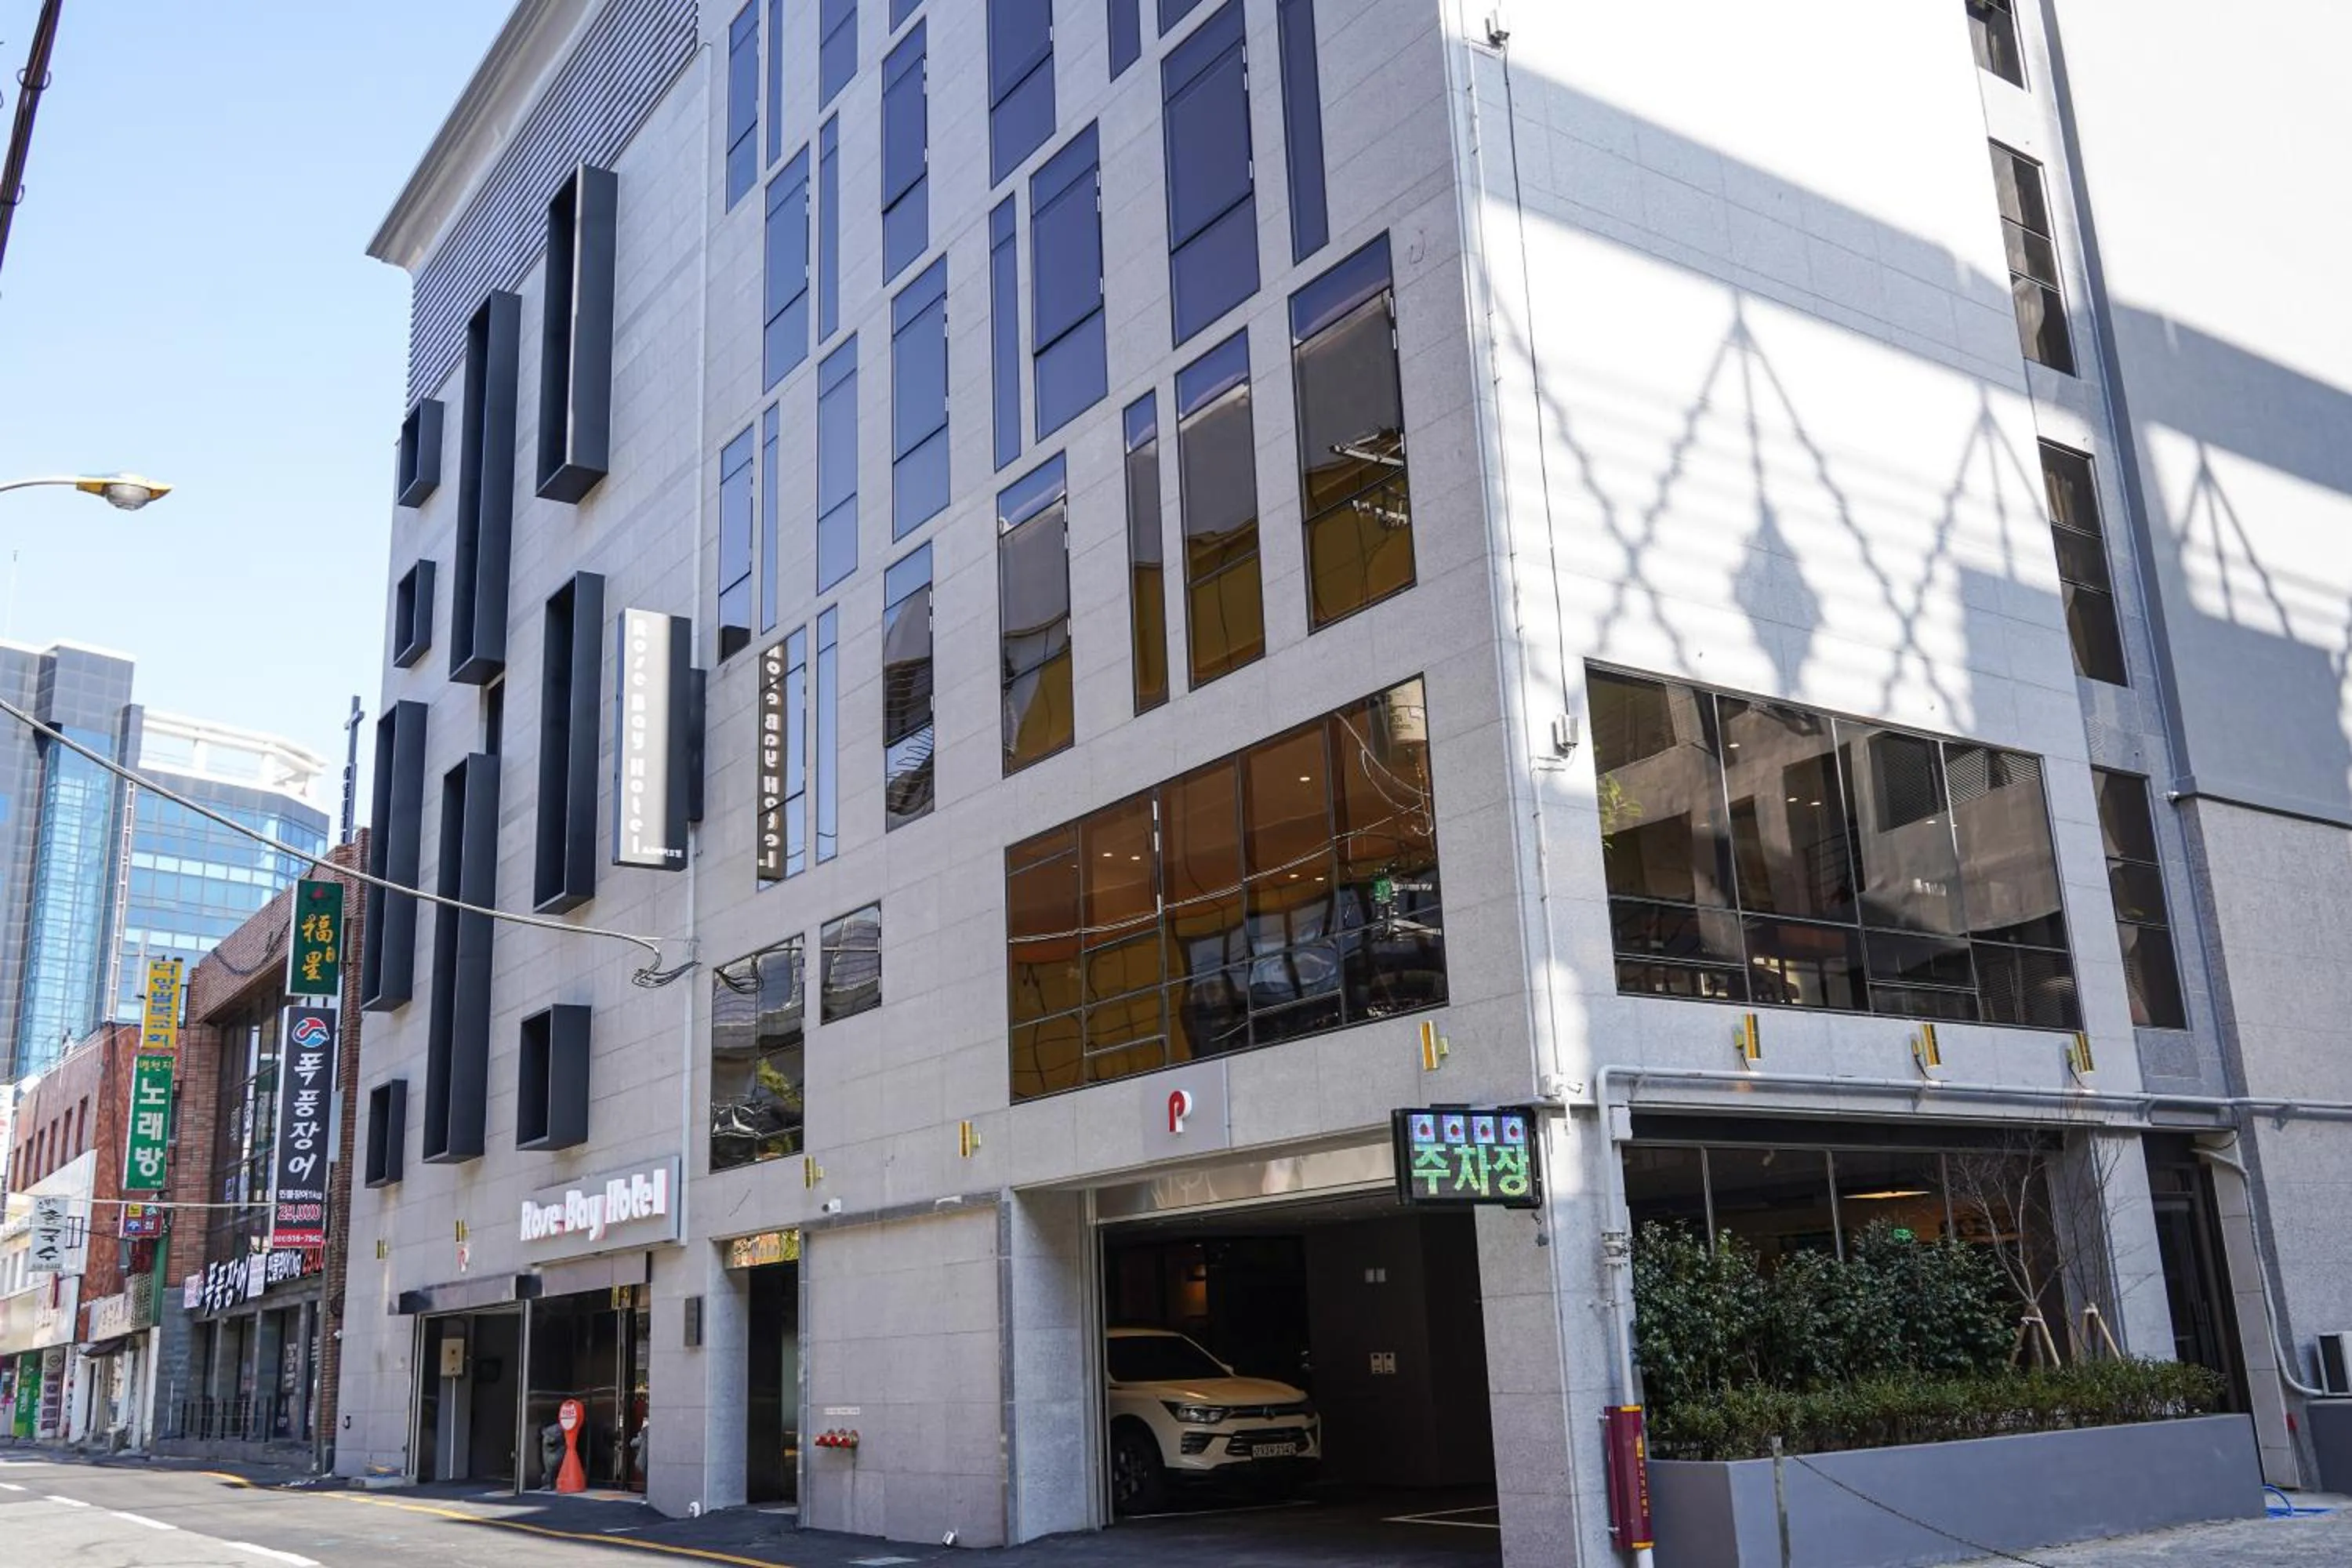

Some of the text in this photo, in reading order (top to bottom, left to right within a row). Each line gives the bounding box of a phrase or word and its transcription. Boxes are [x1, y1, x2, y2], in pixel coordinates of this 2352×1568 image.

[630, 757, 644, 855] Hotel
[135, 1077, 165, 1177] 노래방
[288, 1052, 325, 1182] 폭풍장어
[521, 1168, 666, 1241] Rose Bay Hotel
[1412, 1143, 1530, 1196] 주차장
[205, 1255, 250, 1318] 폭풍장어
